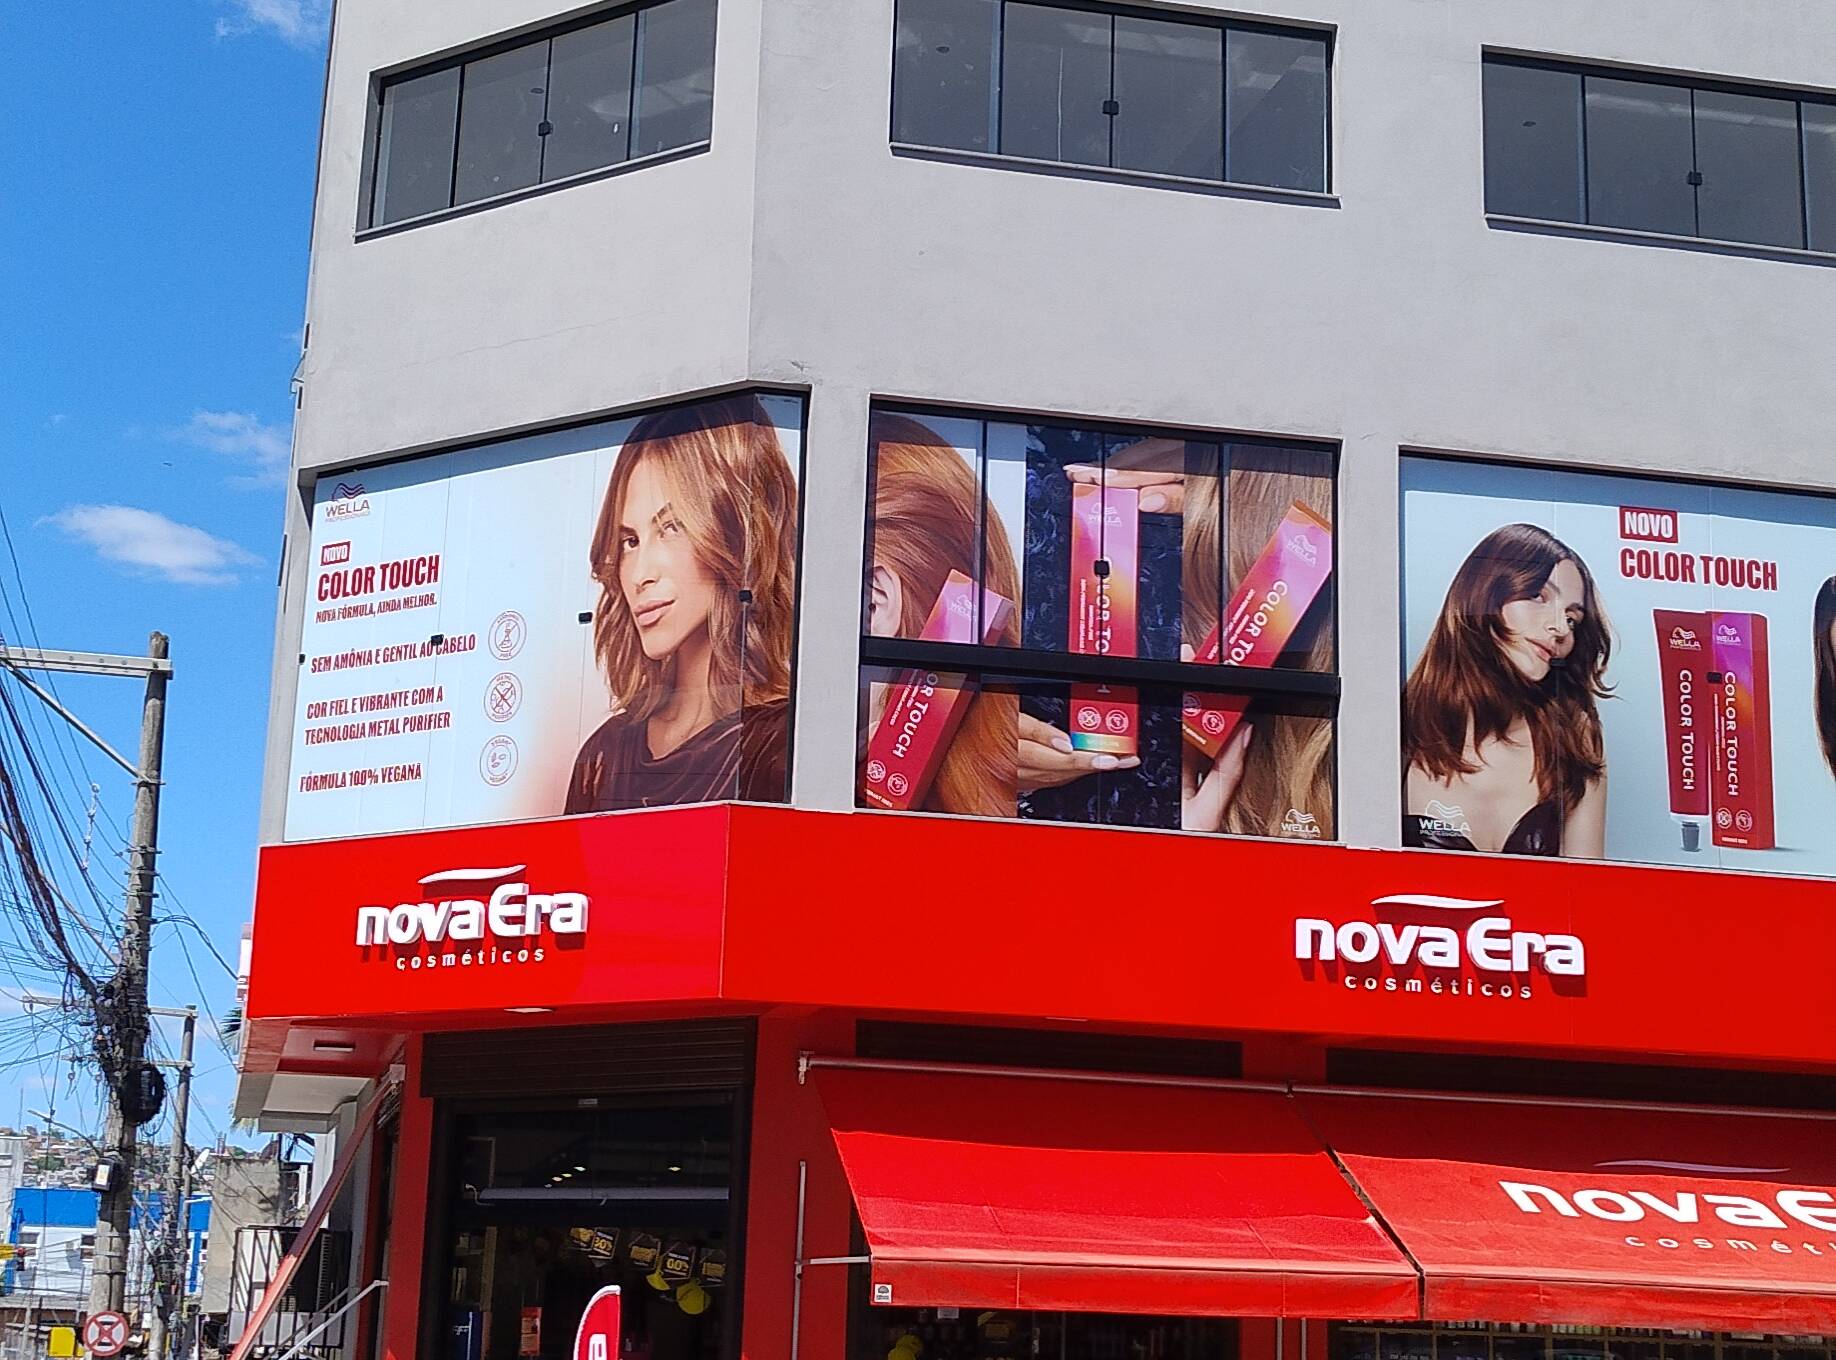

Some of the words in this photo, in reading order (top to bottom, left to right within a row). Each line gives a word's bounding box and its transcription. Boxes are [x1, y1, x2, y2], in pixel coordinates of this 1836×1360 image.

[326, 500, 370, 517] WELLA
[1624, 511, 1673, 538] NOVO
[317, 566, 376, 601] COLOR
[380, 554, 440, 591] TOUCH
[1620, 548, 1696, 583] COLOR
[1700, 555, 1777, 591] TOUCH
[315, 609, 337, 624] NOVA
[337, 603, 376, 621] FÓRMULA,
[377, 599, 402, 615] AINDA
[403, 592, 437, 609] MELHOR.
[1245, 580, 1289, 638] COLOR
[311, 654, 332, 674] SEM
[333, 648, 373, 671] AMÔNIA
[374, 648, 382, 665] E
[382, 642, 417, 664] GENTIL
[419, 640, 434, 658] AO
[434, 633, 476, 656] CABELO
[1669, 638, 1701, 648] WELLA
[307, 703, 328, 720] COR
[328, 698, 349, 717] FIEL
[351, 696, 359, 714] E
[359, 690, 409, 713] VIBRANTE
[411, 686, 436, 706] COM
[436, 685, 444, 703] A
[1679, 669, 1693, 727] COLOR
[1724, 671, 1737, 731] COLOR
[305, 722, 366, 746] TECNOLOGIA
[367, 717, 401, 738] METAL
[402, 711, 451, 734] PURIFIER
[891, 700, 928, 759] TOUCH
[300, 770, 347, 793] FÓRMULA
[349, 767, 380, 787] 100%
[381, 762, 422, 784] VEGANA
[1682, 731, 1695, 790] TOUCH
[1727, 736, 1739, 796] TOUCH
[1281, 822, 1321, 834] WELLA
[1419, 818, 1472, 833] WELLA
[396, 947, 545, 971] cosméticos
[1344, 975, 1532, 999] cosméticos
